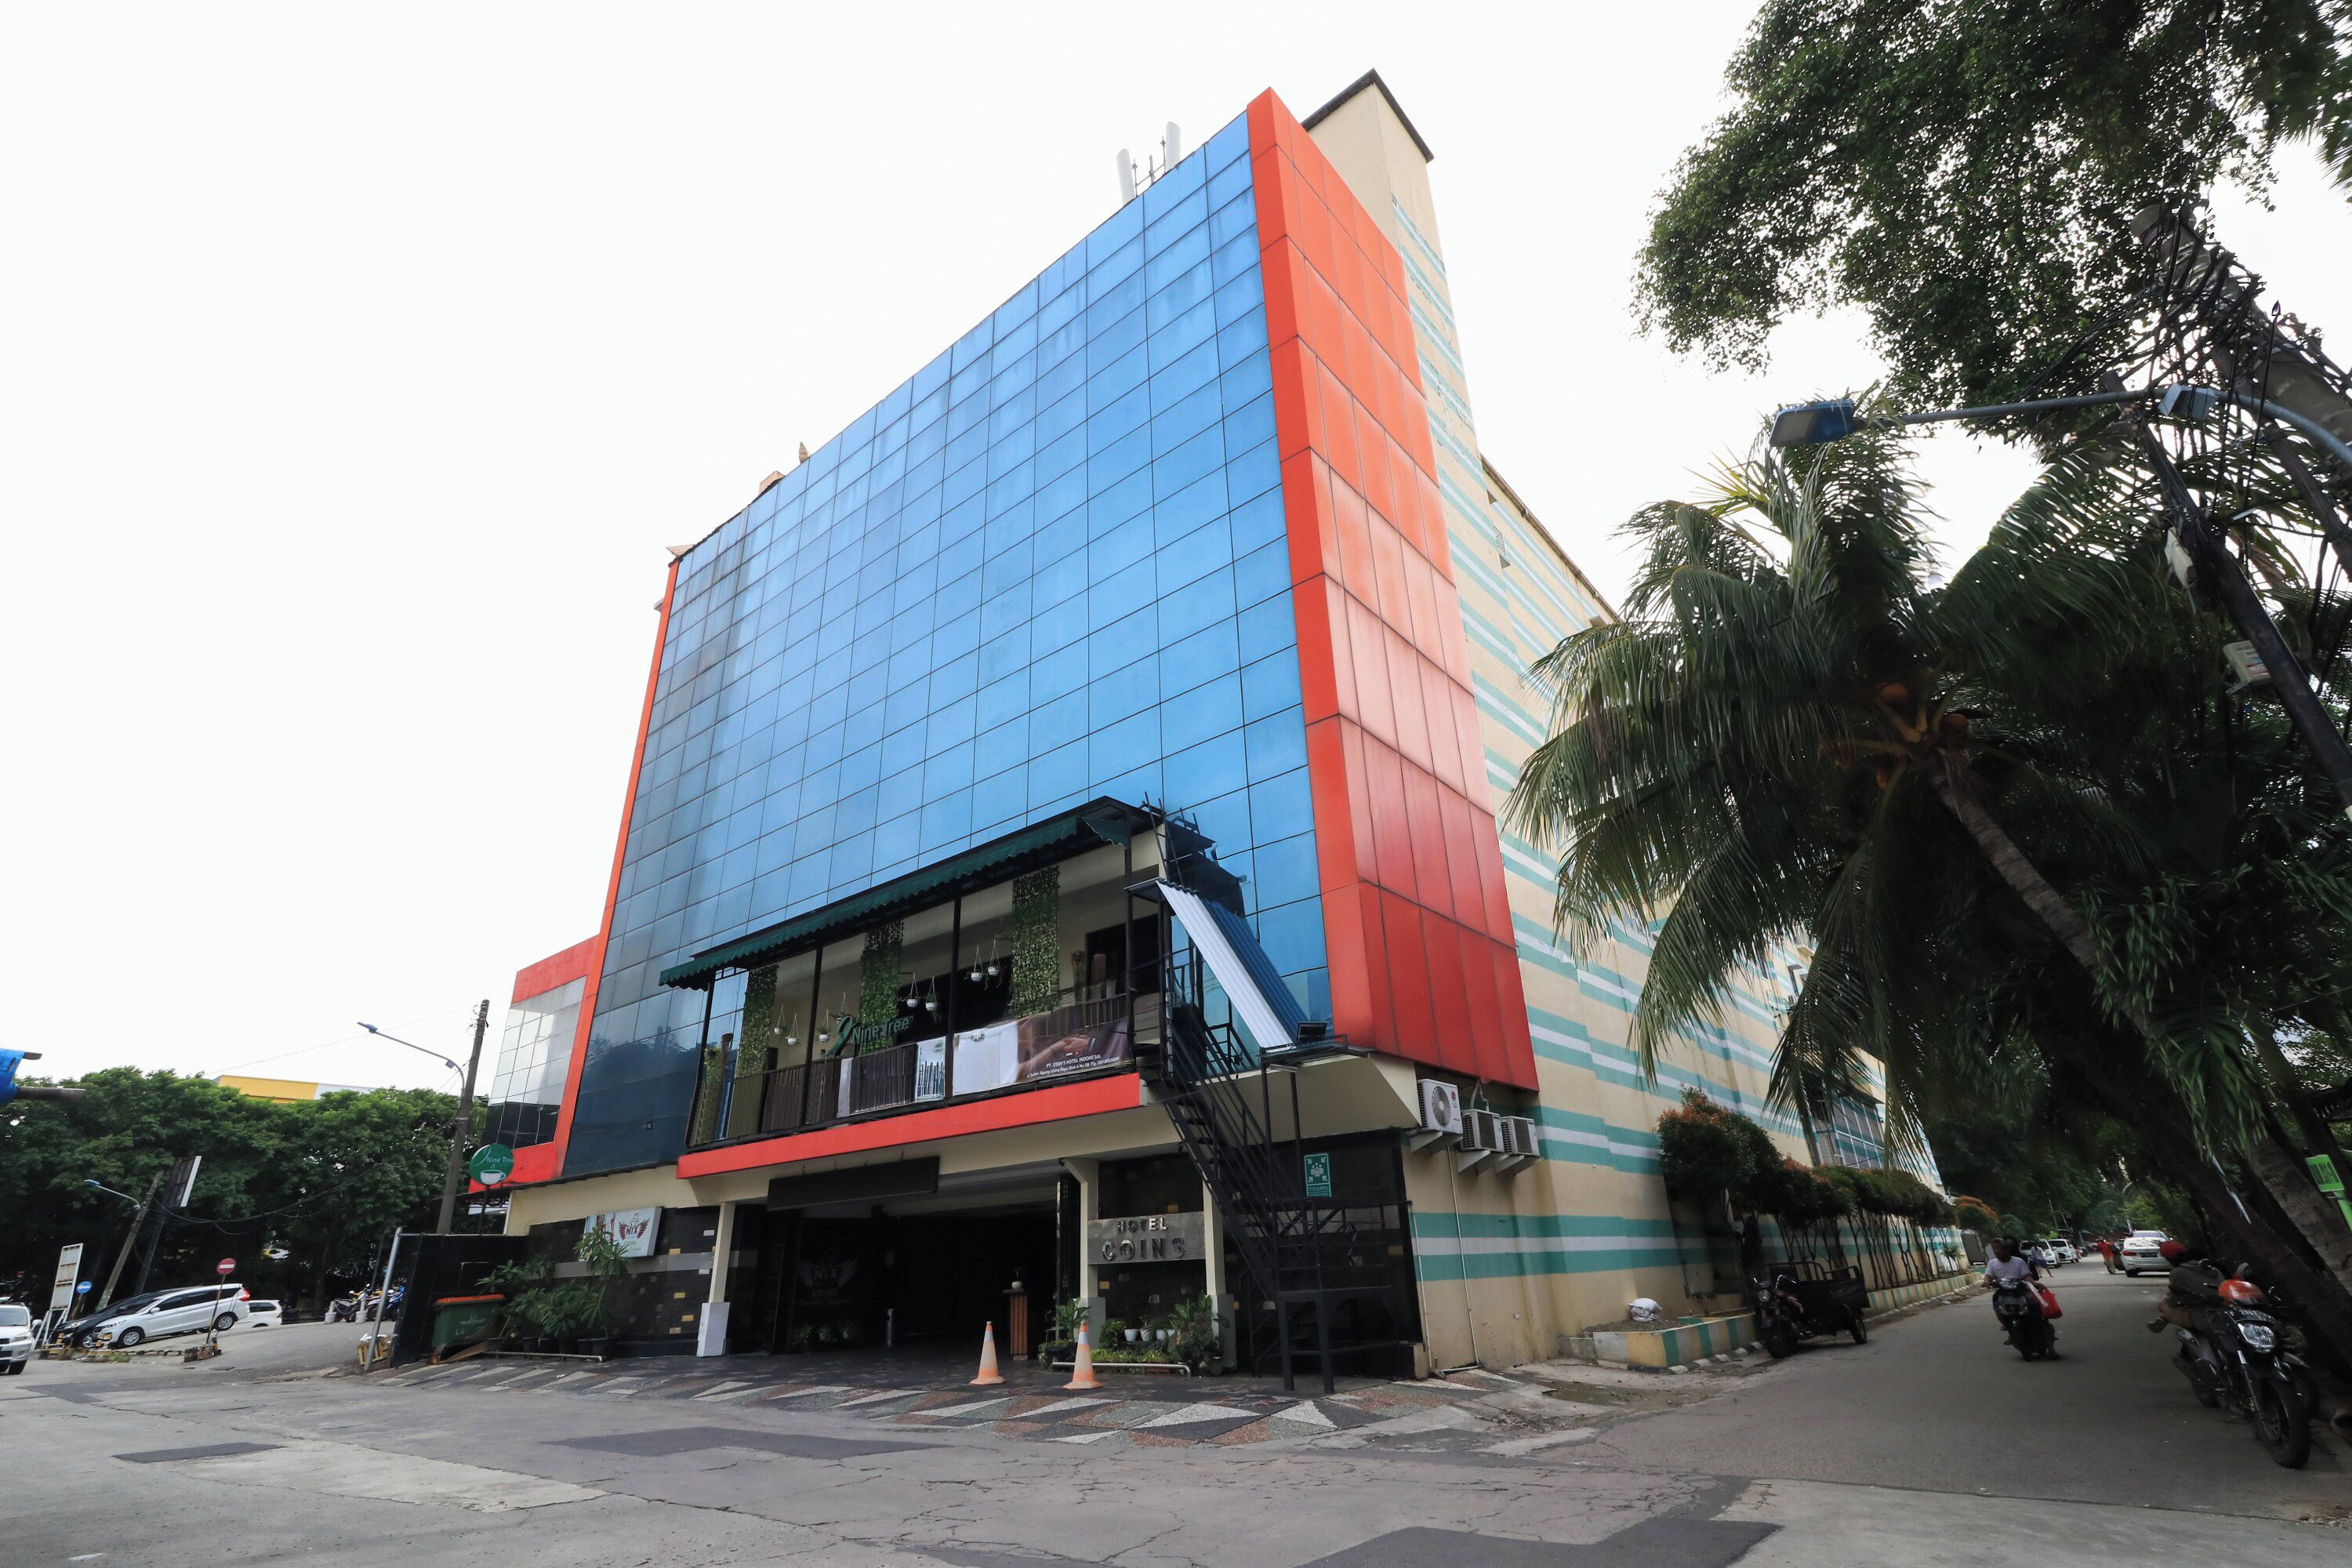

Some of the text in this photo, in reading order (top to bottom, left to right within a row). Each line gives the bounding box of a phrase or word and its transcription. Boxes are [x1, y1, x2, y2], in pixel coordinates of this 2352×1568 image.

[852, 1025, 878, 1042] Nine
[883, 1017, 909, 1036] Tree
[1116, 1217, 1167, 1233] HOTEL
[1102, 1236, 1185, 1261] COINS
